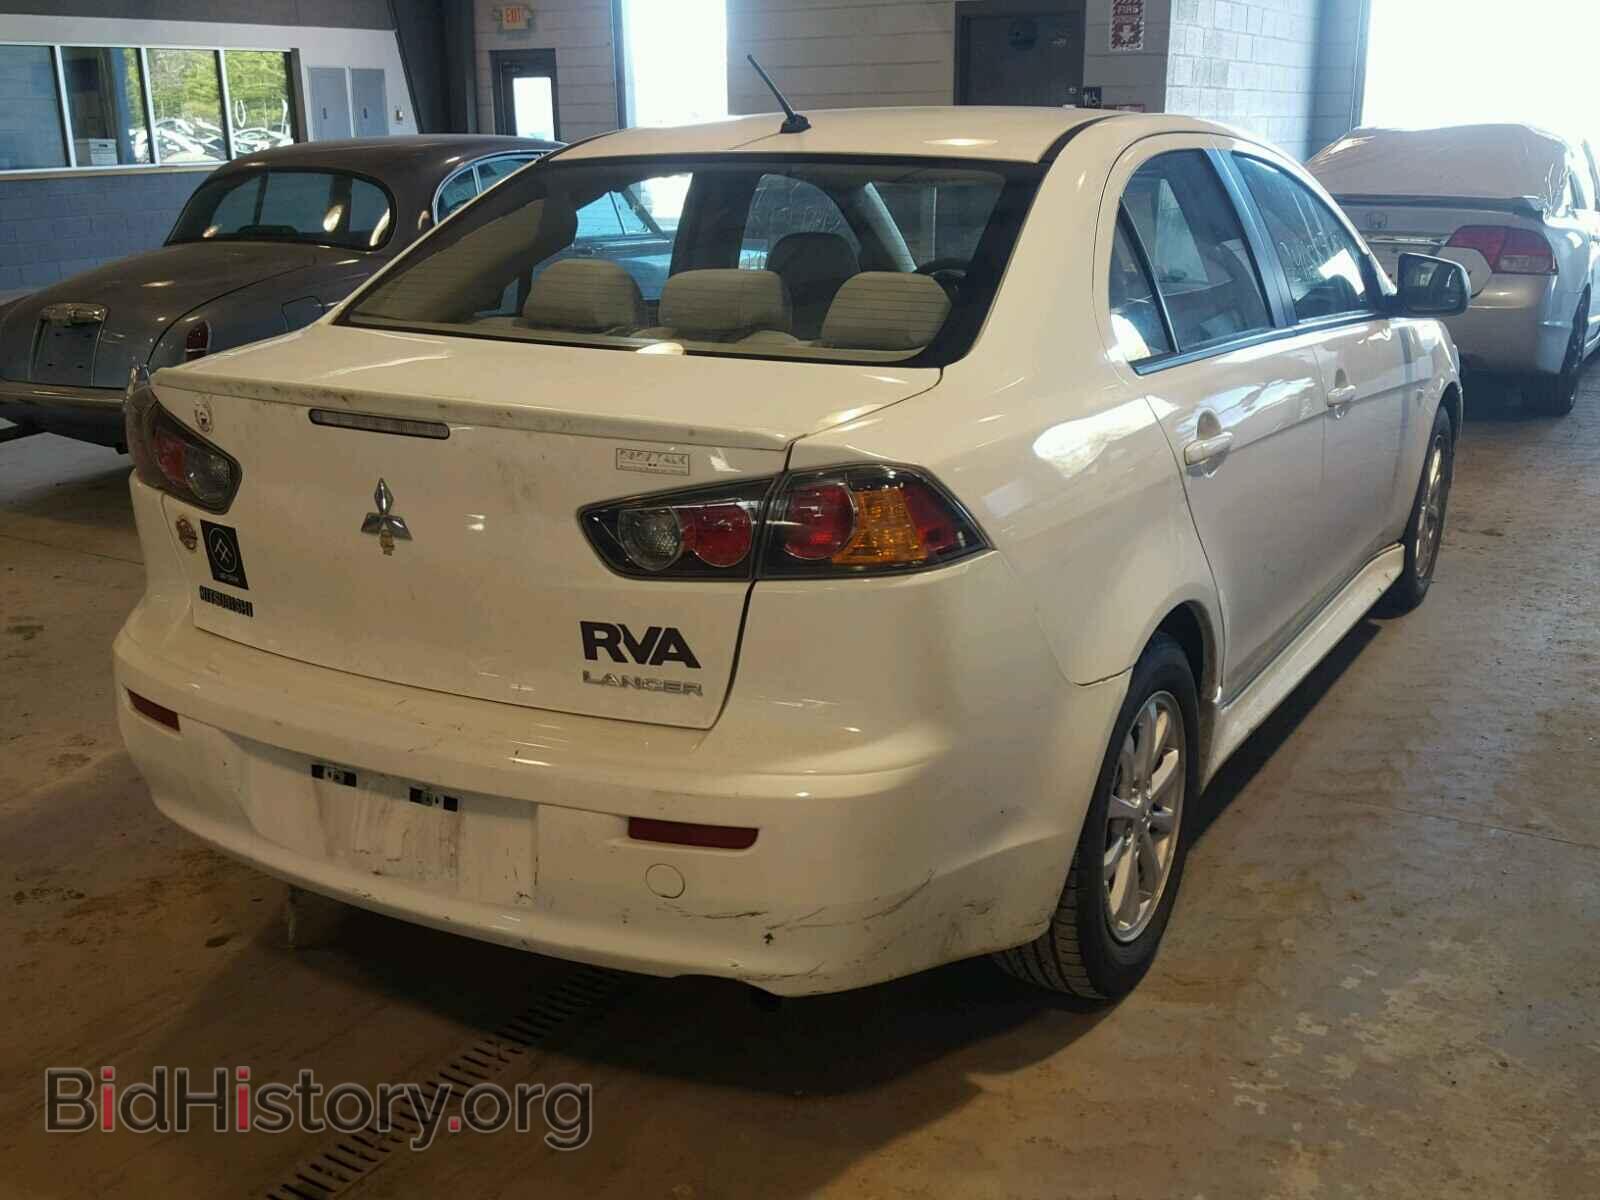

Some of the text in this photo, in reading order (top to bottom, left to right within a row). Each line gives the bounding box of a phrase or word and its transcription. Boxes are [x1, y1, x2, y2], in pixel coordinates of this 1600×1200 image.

[505, 7, 522, 24] EXIT
[580, 620, 701, 669] RVA
[582, 669, 704, 697] LANCER
